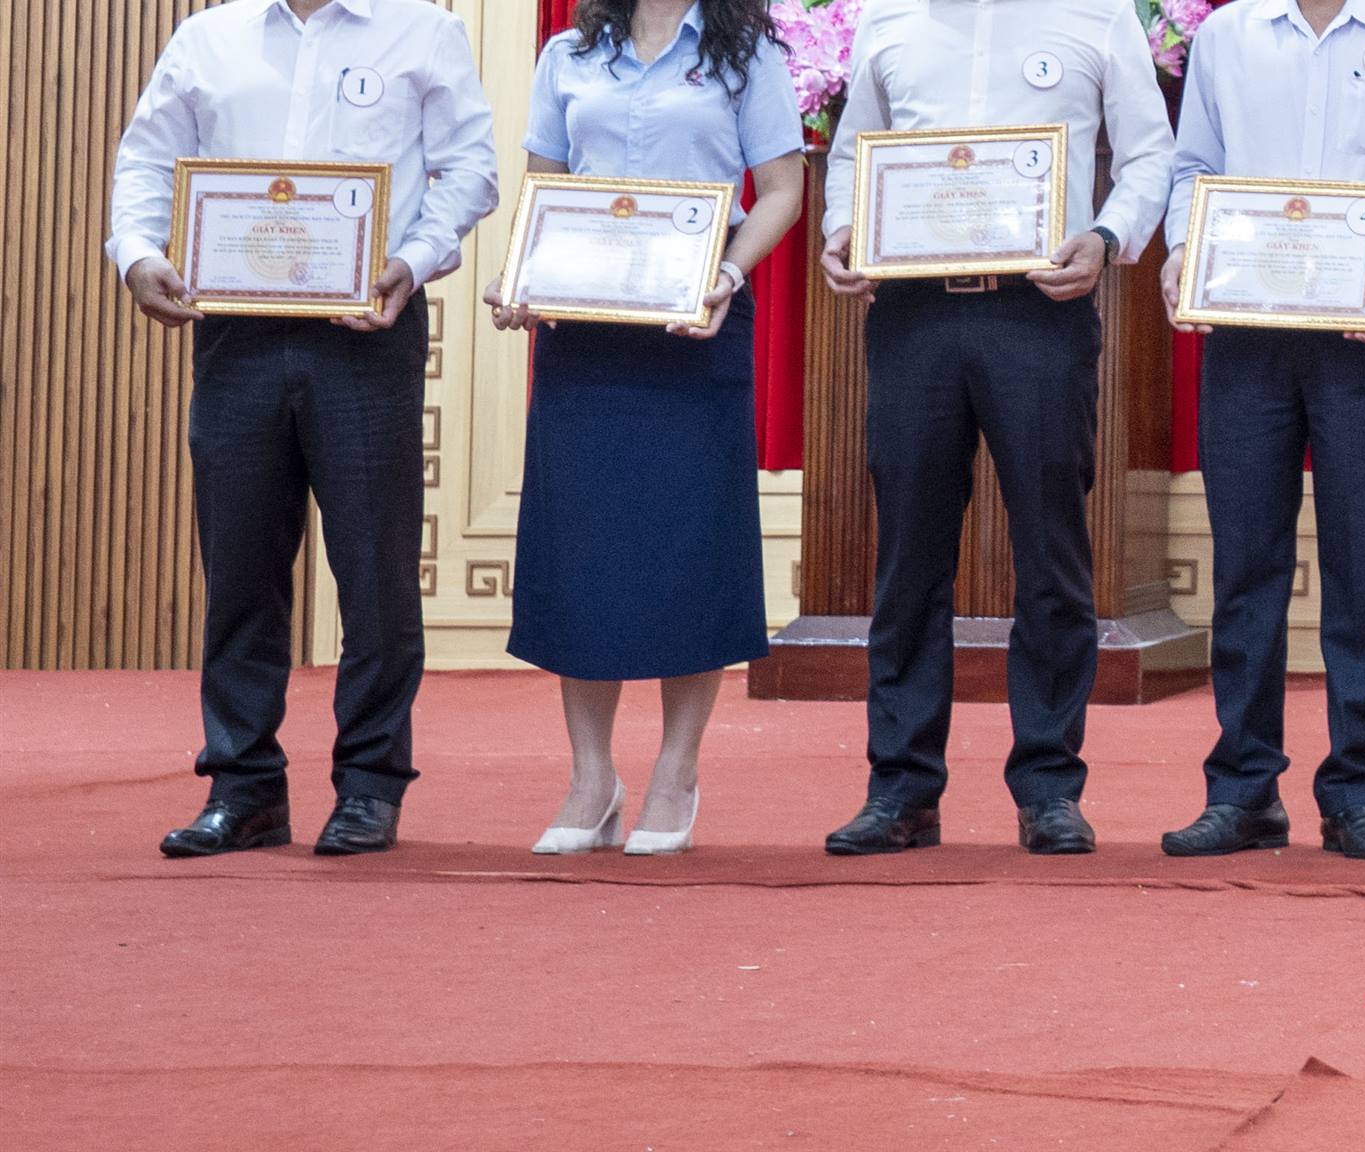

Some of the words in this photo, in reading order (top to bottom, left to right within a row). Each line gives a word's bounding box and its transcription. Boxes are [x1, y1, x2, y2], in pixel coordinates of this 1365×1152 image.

[1036, 61, 1048, 78] 3
[1026, 149, 1039, 168] 3
[350, 188, 357, 207] 1
[687, 206, 698, 224] 2
